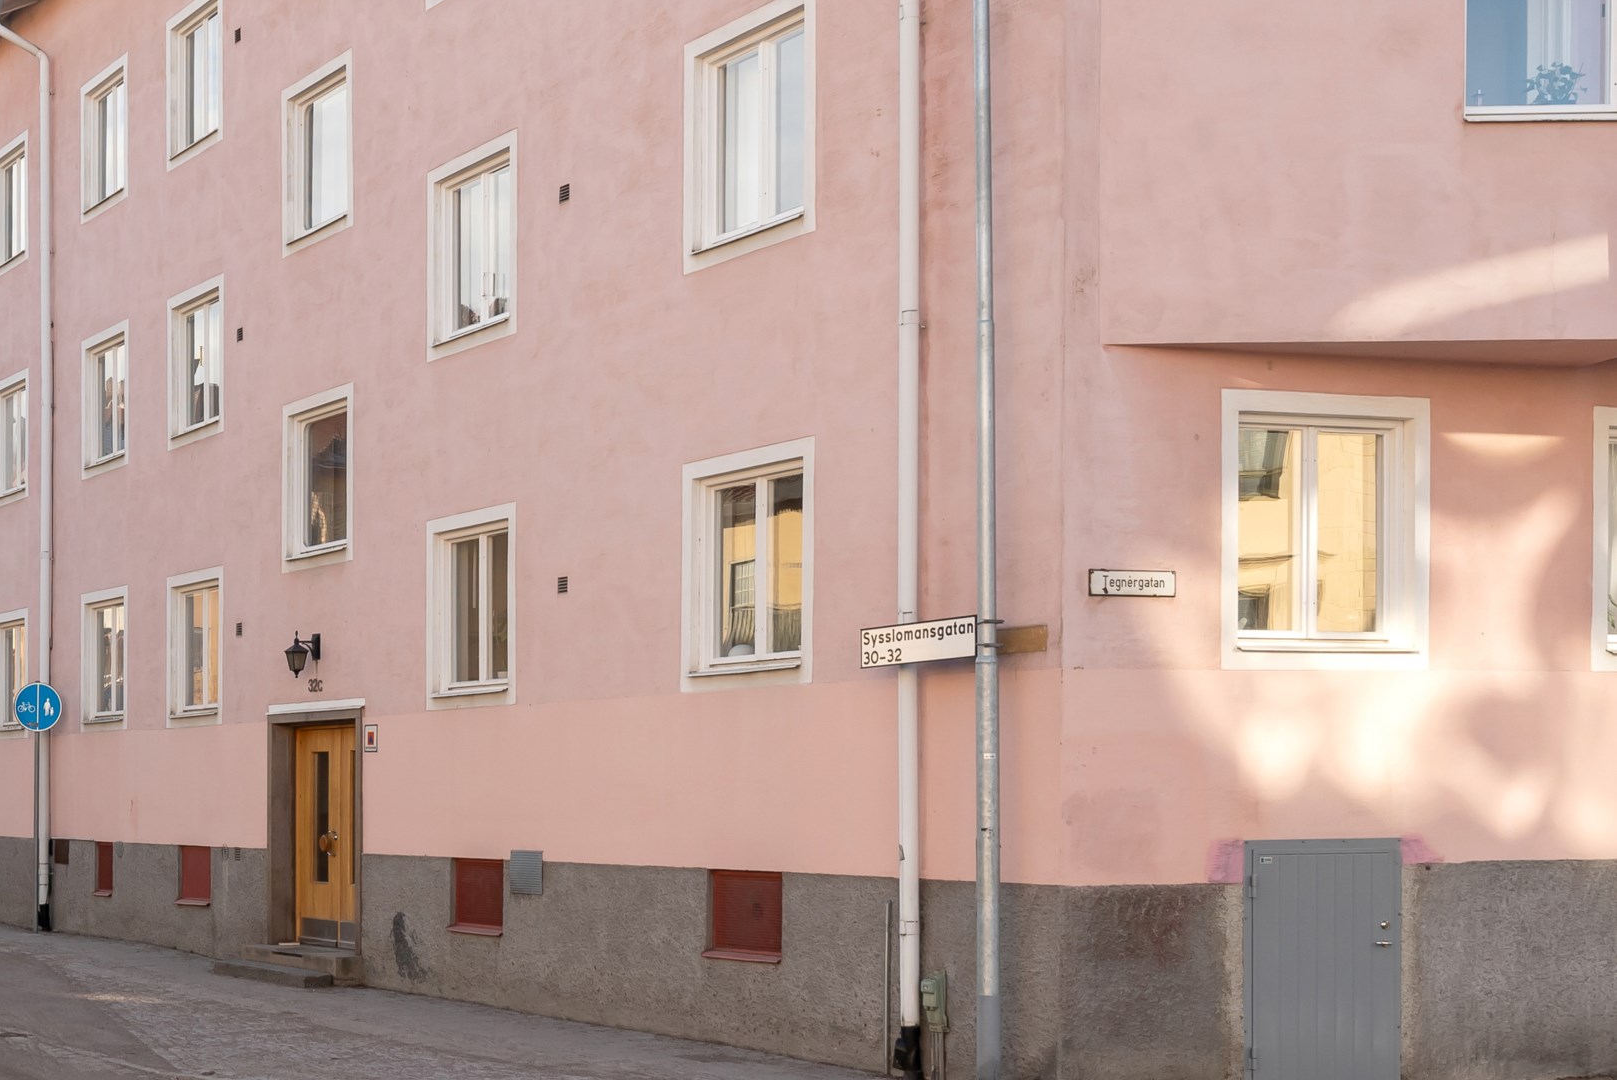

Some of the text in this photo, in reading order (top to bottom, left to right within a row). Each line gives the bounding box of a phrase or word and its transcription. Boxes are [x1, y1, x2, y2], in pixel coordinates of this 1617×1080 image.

[863, 621, 974, 648] Sysslomansgatan
[863, 648, 902, 665] 30-32
[308, 678, 323, 692] 32C
